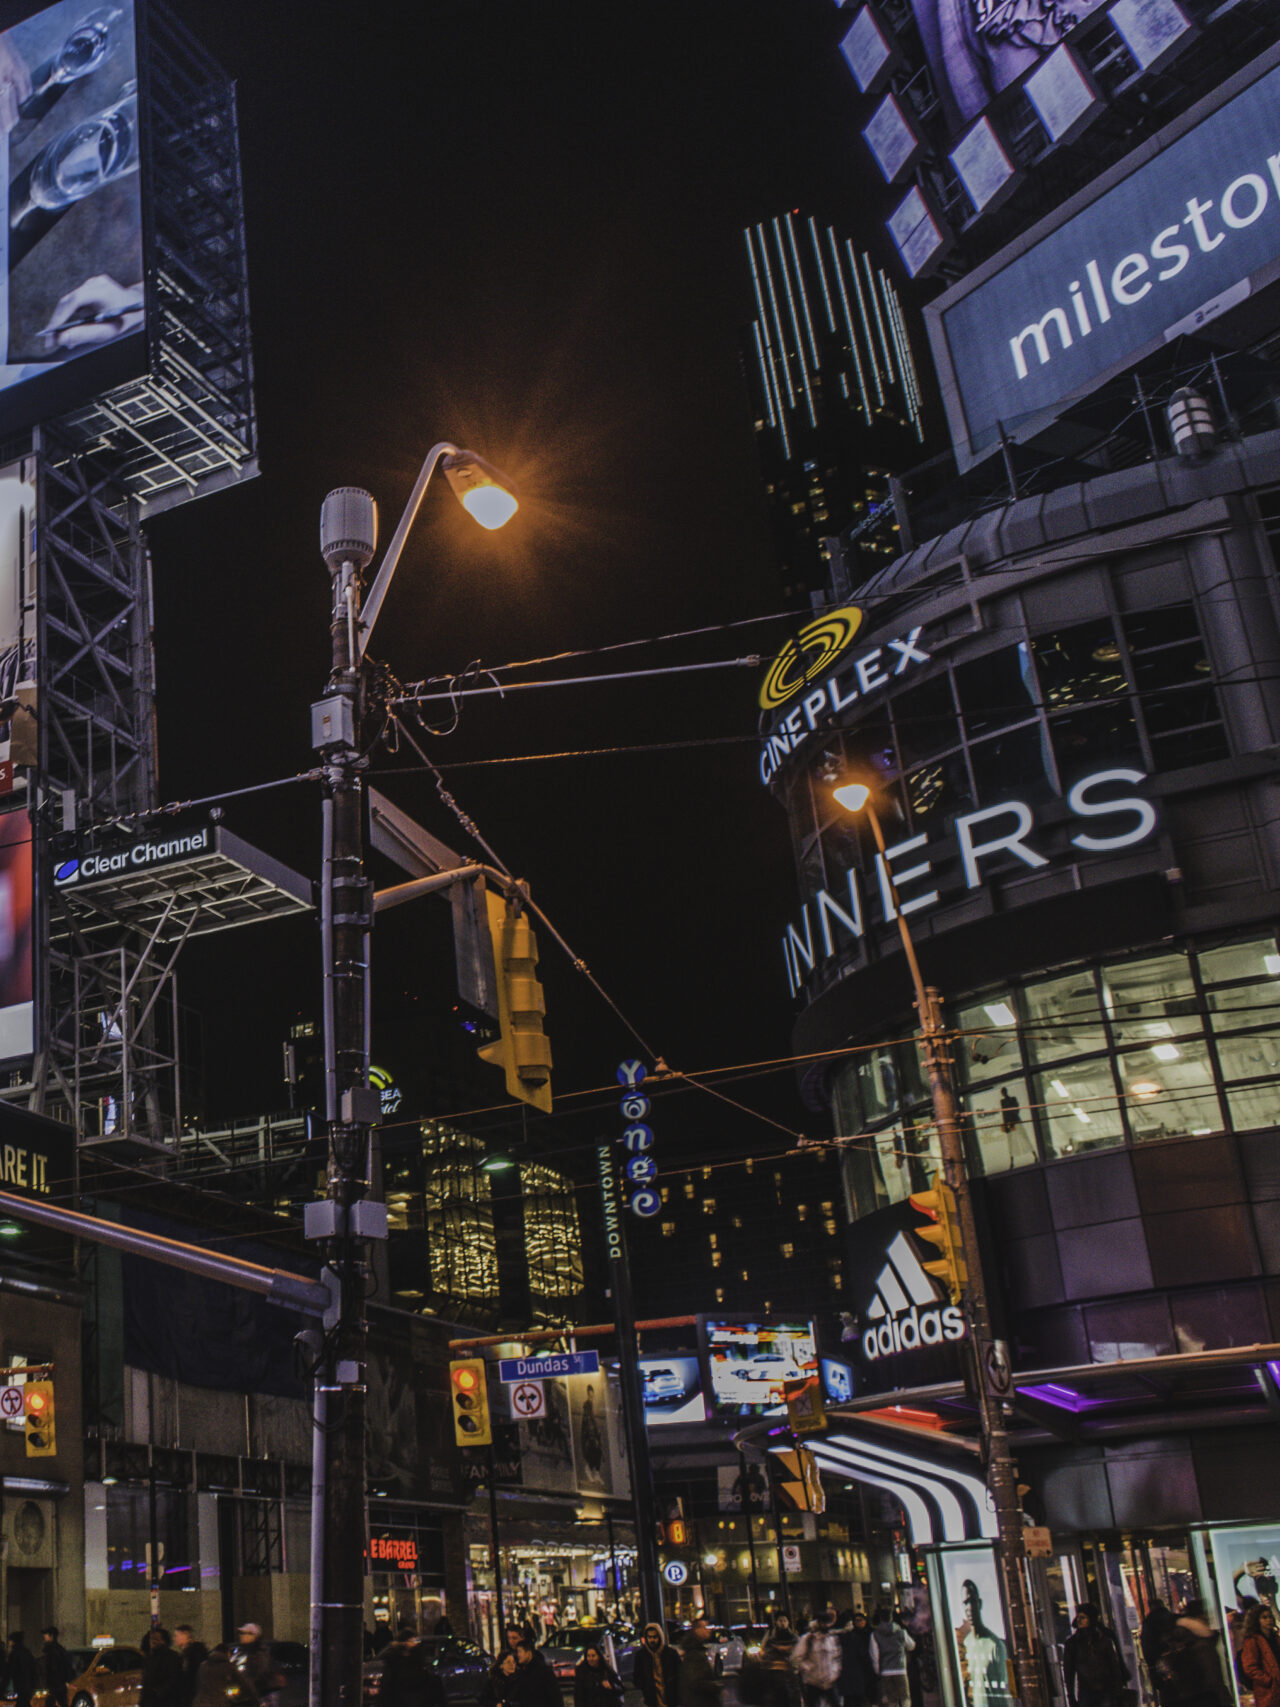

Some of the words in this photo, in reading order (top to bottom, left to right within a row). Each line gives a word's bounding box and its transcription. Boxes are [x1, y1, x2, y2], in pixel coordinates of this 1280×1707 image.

[760, 626, 931, 786] CINEPLEX
[81, 851, 129, 877] Clear
[131, 829, 208, 862] Channel
[620, 1060, 655, 1217] Yonge
[32, 1152, 51, 1194] IT.
[598, 1145, 622, 1258] DOWNTOWN
[863, 1306, 965, 1360] adidas
[517, 1358, 569, 1376] Dundas
[379, 1538, 418, 1560] BARREL
